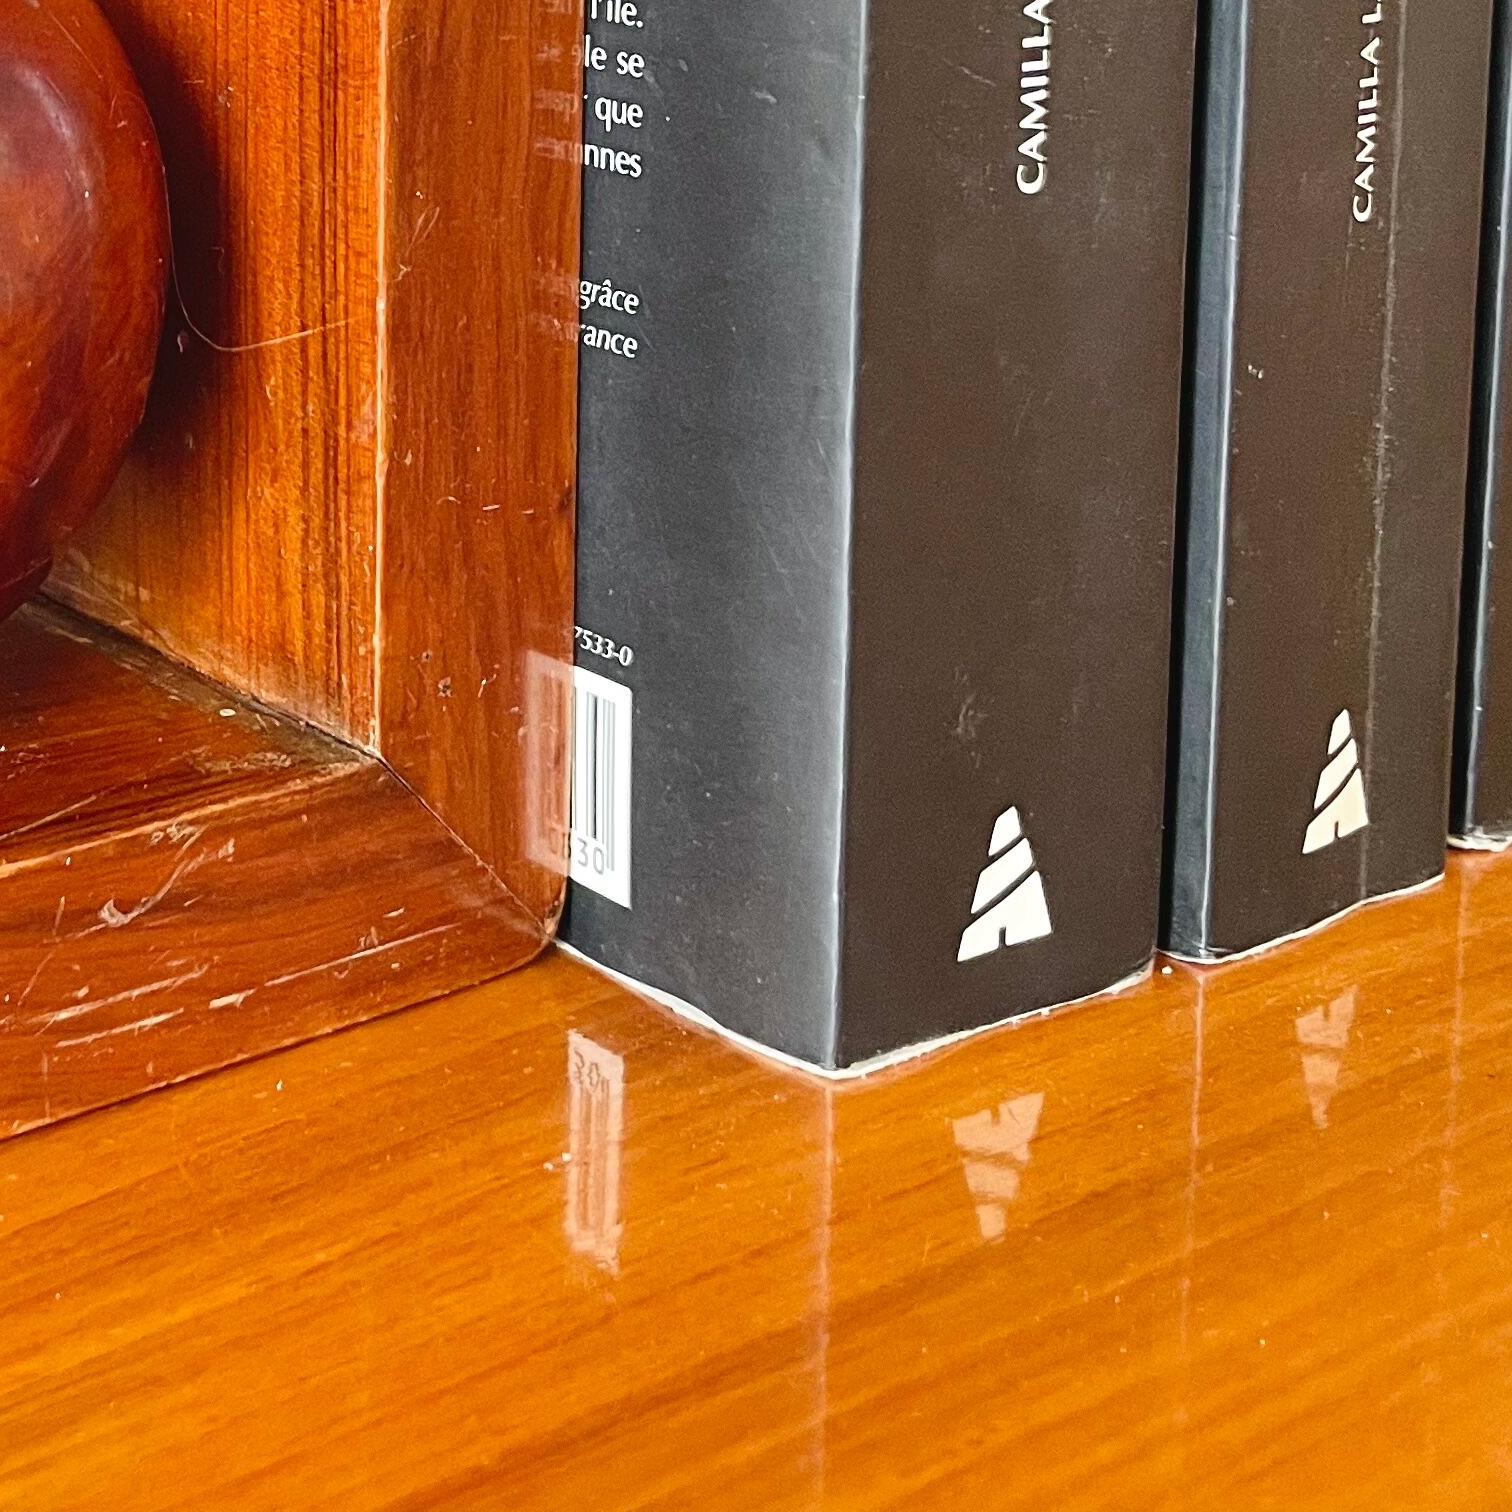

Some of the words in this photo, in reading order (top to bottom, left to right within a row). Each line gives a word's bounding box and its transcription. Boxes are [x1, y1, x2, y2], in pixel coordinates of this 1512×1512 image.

[616, 51, 645, 78] se
[594, 97, 644, 132] que
[1352, 37, 1380, 222] CAMILLA
[580, 279, 640, 315] grâce
